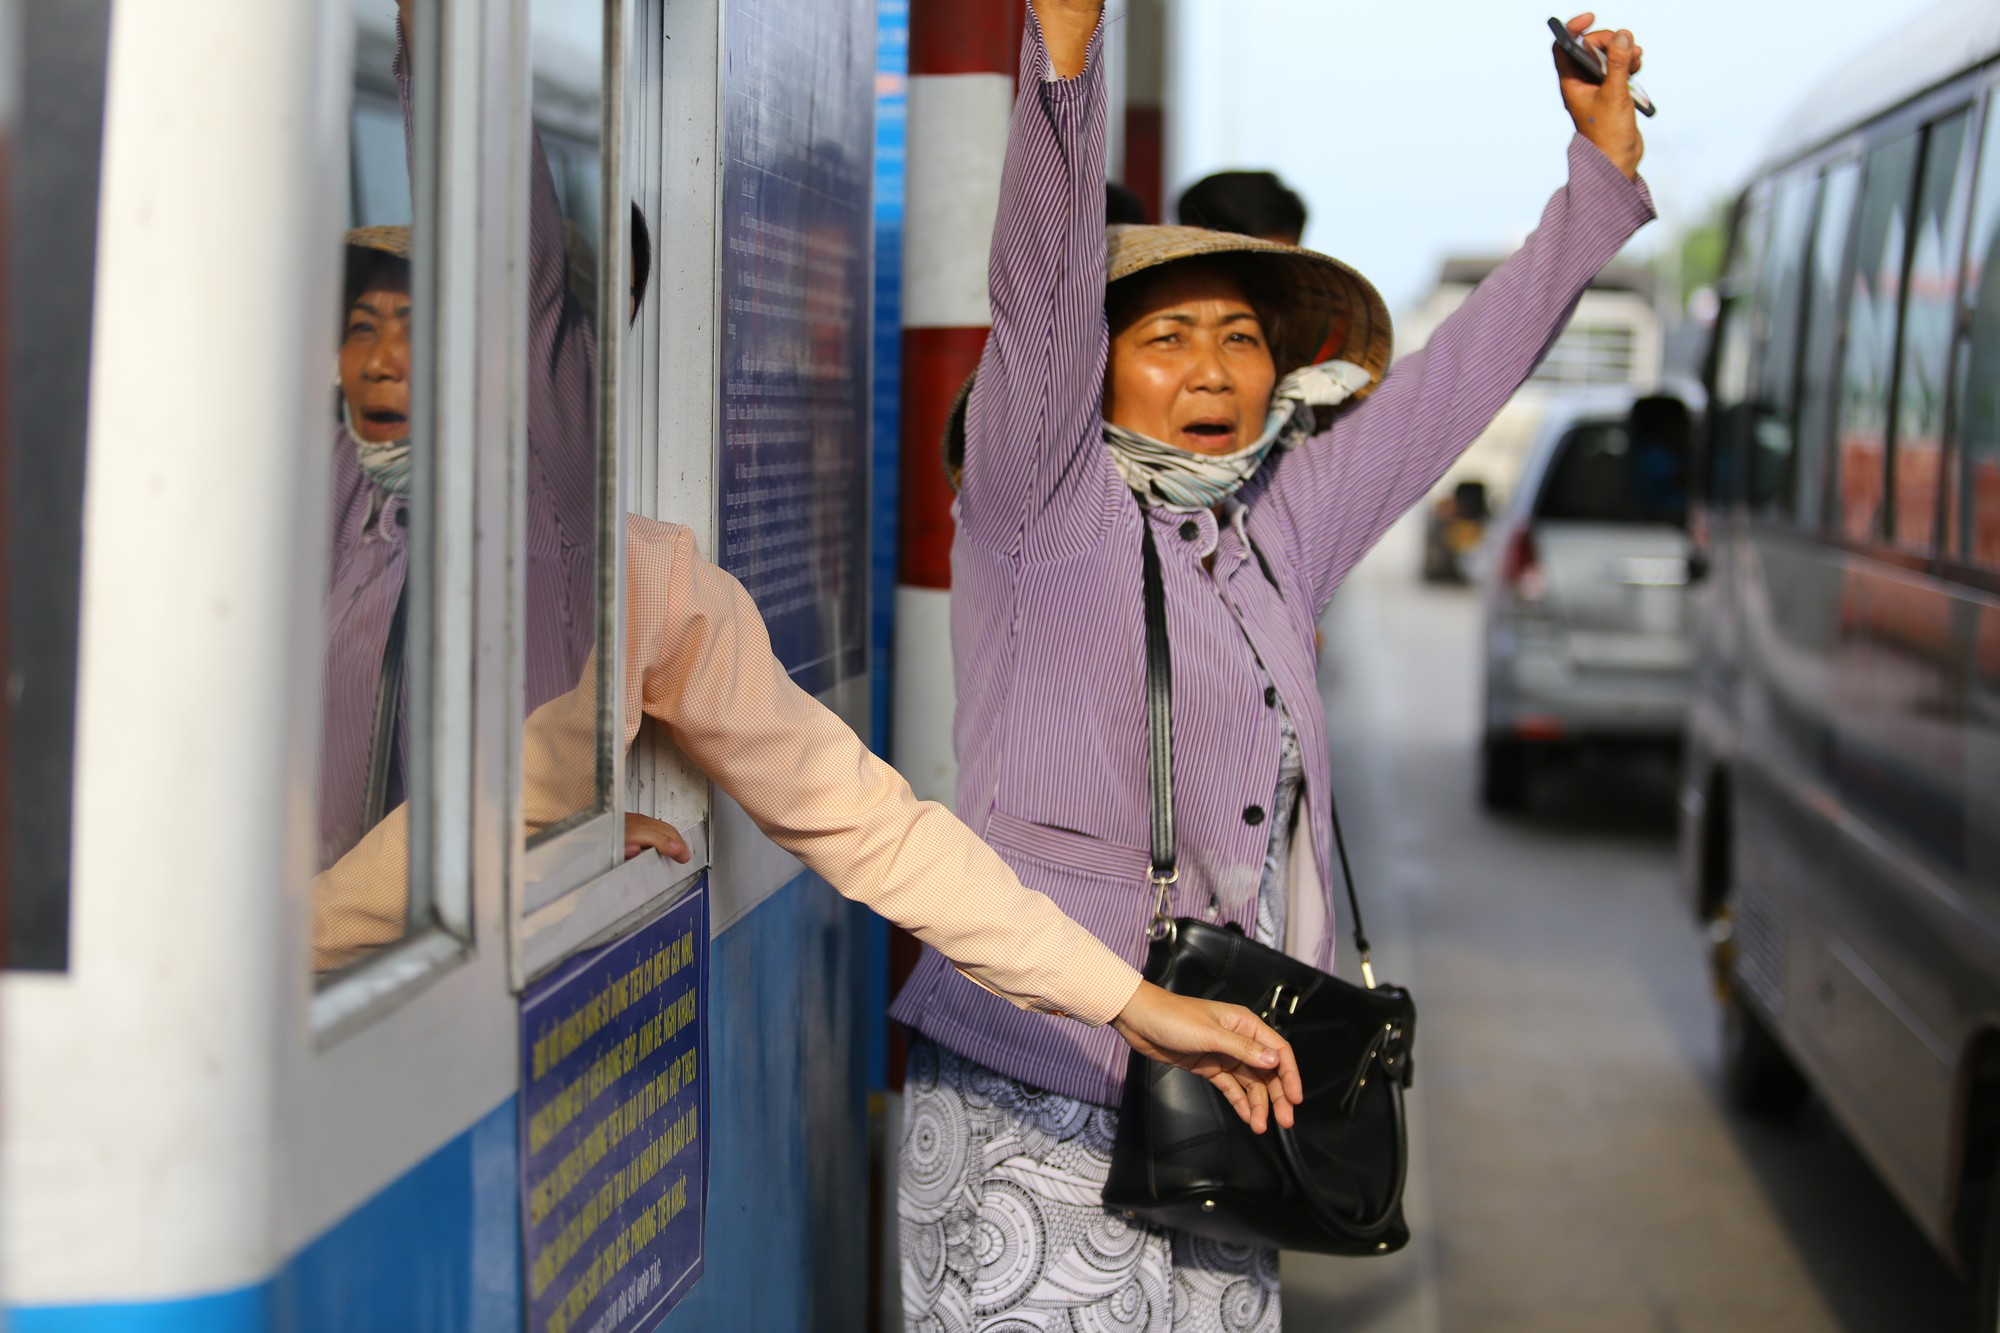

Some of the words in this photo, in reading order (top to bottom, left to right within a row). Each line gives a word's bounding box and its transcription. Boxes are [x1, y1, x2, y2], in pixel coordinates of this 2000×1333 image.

[645, 947, 653, 995] CÓ
[654, 941, 670, 992] MỆNH
[671, 929, 680, 976] GIÁ
[624, 1025, 638, 1073] GÓP,
[639, 1015, 653, 1062] KÍNH
[664, 1001, 677, 1043] NGHỊ
[678, 983, 696, 1031] KHÁCH
[638, 1088, 645, 1131] VỊ
[645, 1070, 655, 1119] TRÍ
[657, 1060, 668, 1110] PHÙ
[670, 1056, 681, 1103] HỢP
[682, 1046, 697, 1088] THEO
[614, 1167, 625, 1214] TẠI
[626, 1151, 639, 1199] LÀN
[660, 1118, 672, 1170] ĐẢM
[673, 1105, 685, 1157] BẢO
[603, 1241, 615, 1286] CHO
[616, 1222, 630, 1271] CÁC
[631, 1203, 657, 1258] PHƯƠNG
[657, 1185, 670, 1235] TIỆN
[671, 1168, 687, 1219] KHÁC
[628, 1276, 637, 1315] SỰ
[637, 1268, 650, 1306] HỢP
[650, 1253, 661, 1291] TÁC
